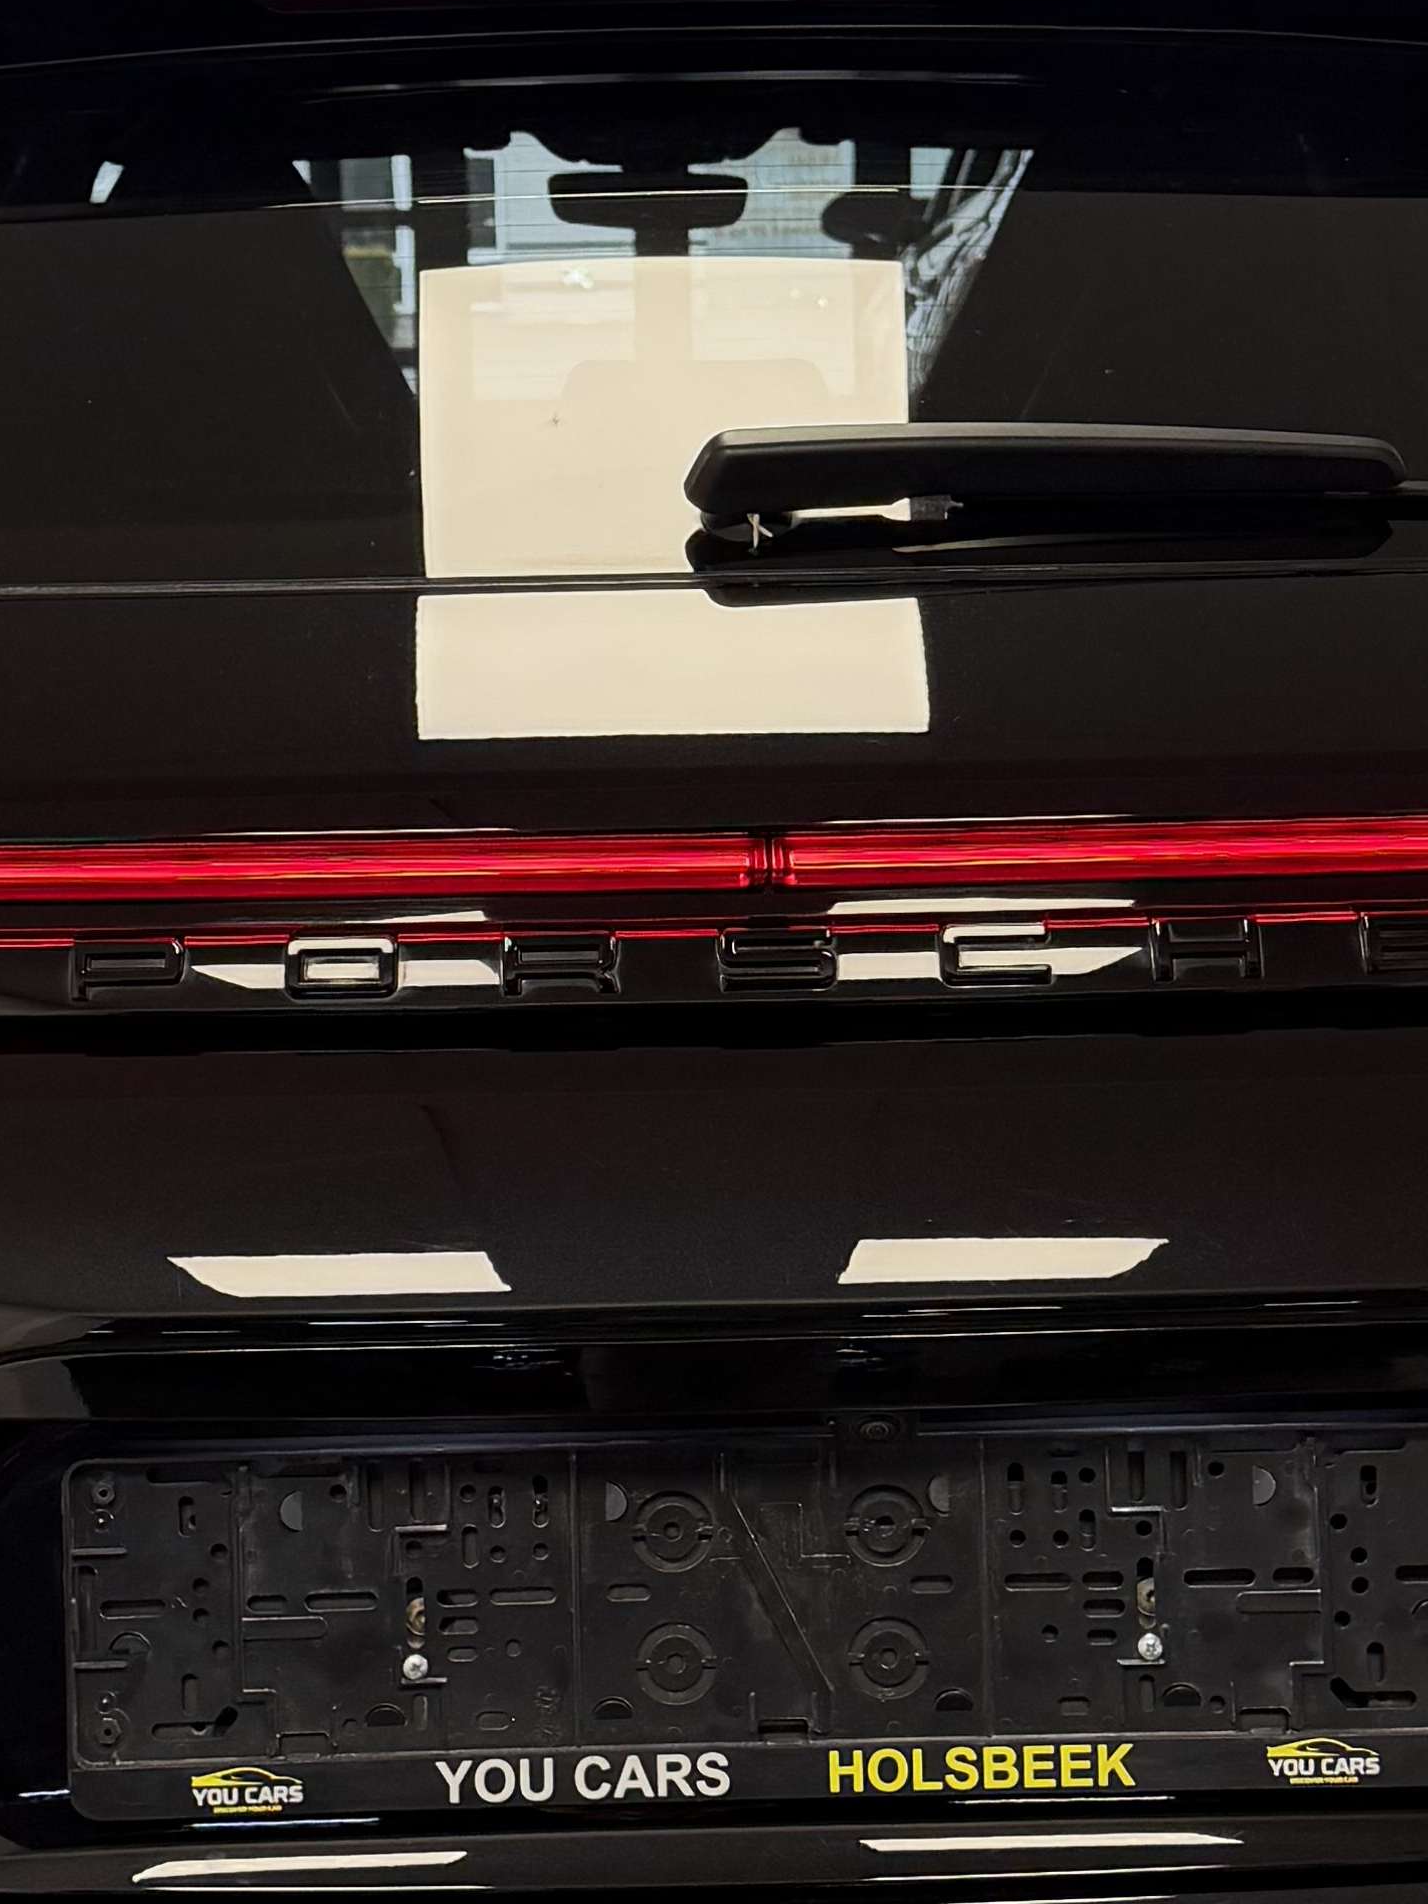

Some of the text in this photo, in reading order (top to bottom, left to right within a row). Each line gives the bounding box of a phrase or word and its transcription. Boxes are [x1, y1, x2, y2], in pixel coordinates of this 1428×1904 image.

[435, 1744, 1136, 1804] YOU CARS HOLSBEEK
[1268, 1757, 1380, 1776] YOU CARS
[192, 1785, 304, 1806] YOU CARS
